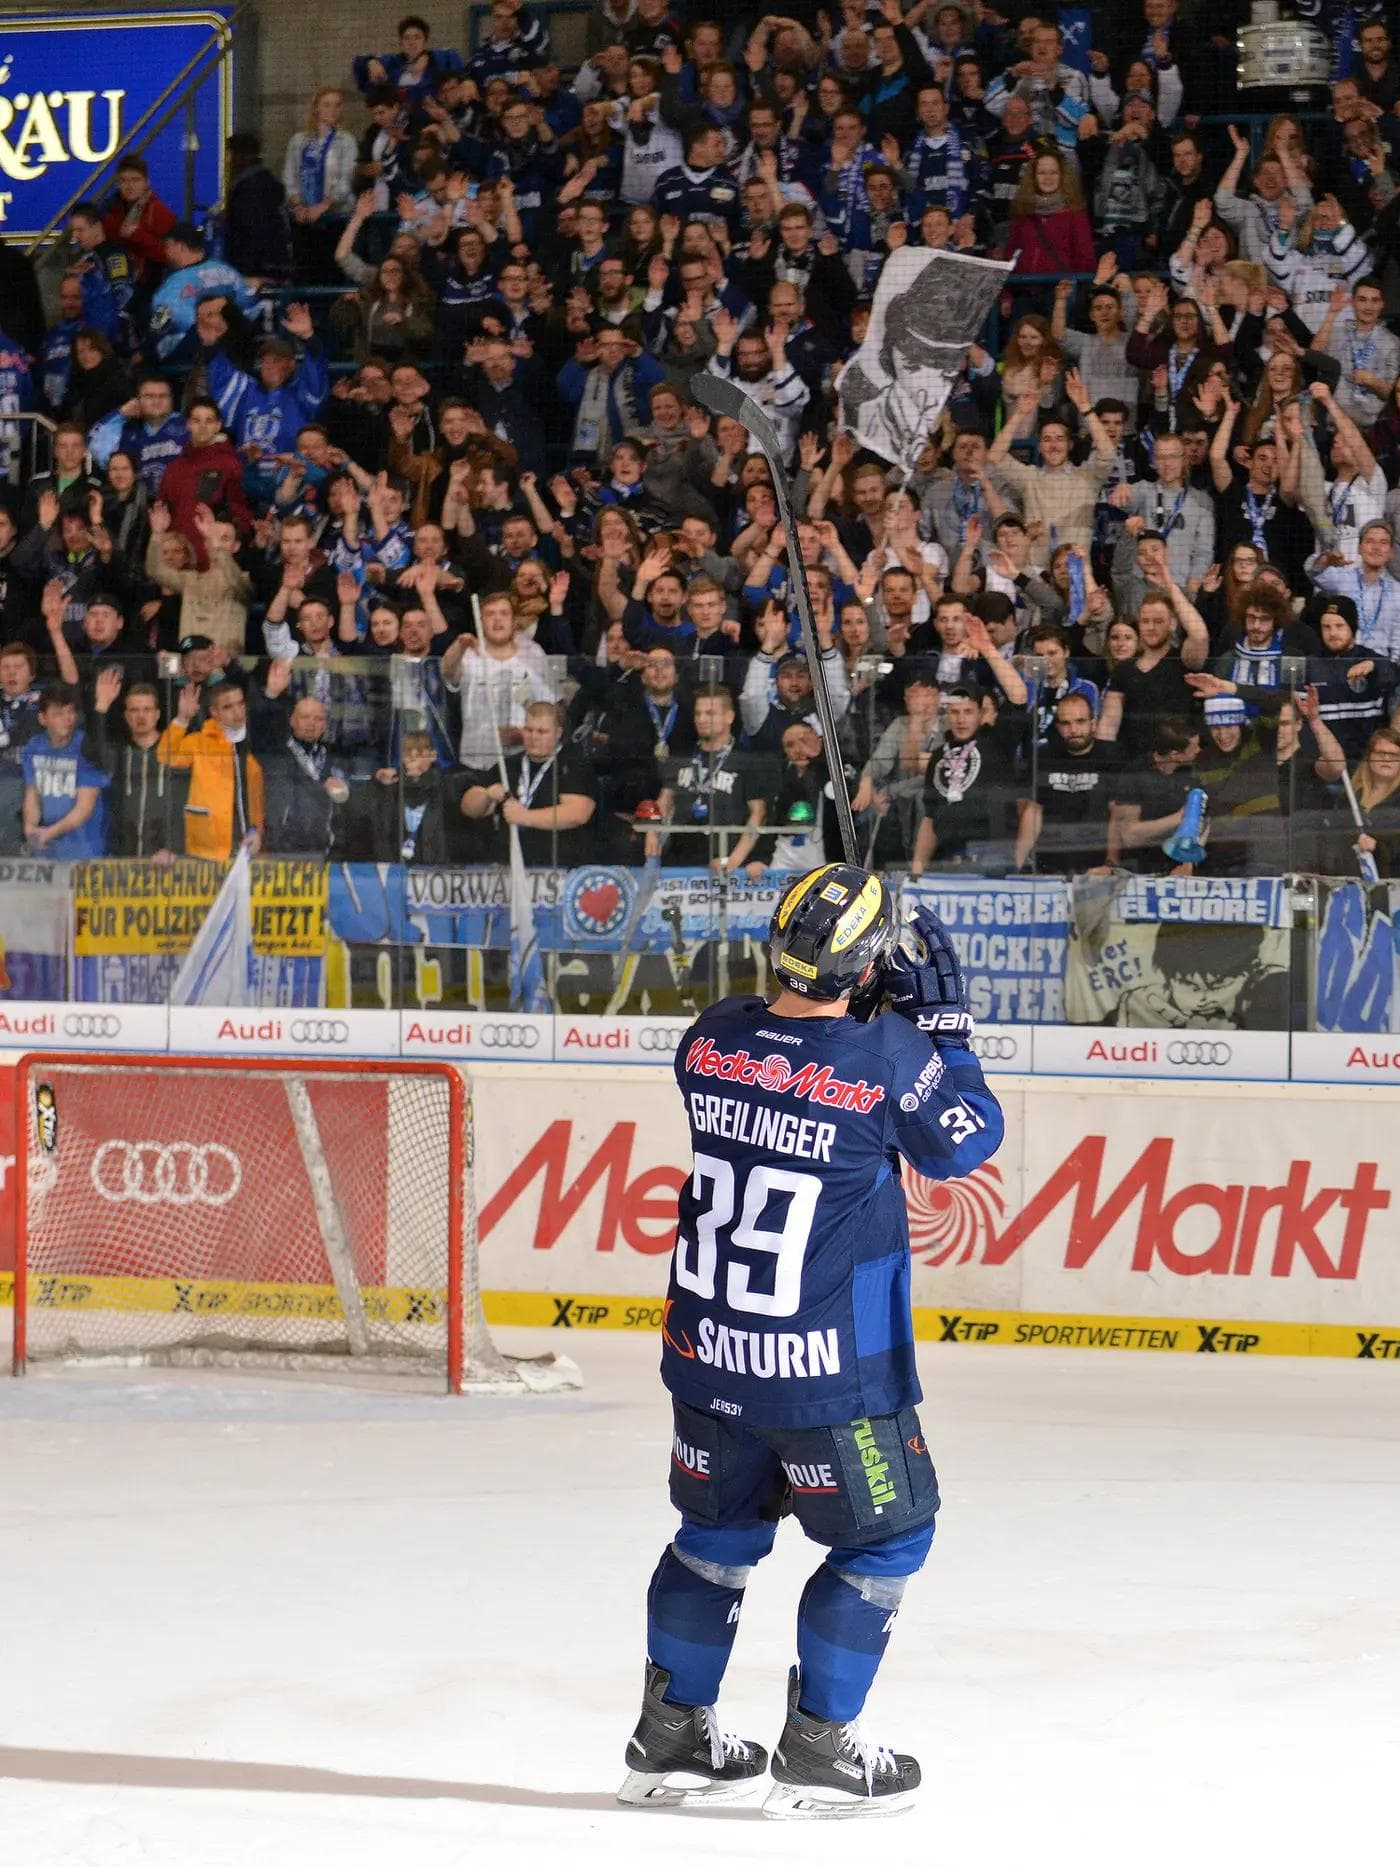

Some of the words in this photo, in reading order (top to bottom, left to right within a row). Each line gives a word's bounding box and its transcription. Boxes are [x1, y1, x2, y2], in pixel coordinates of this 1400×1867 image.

[711, 877, 739, 889] DR
[76, 902, 117, 937] FÜR
[1158, 897, 1268, 923] CUORE
[781, 954, 816, 975] EDEKA
[950, 932, 1066, 974] HOCKEY
[789, 977, 808, 993] 39
[969, 976, 1065, 1021] STER
[219, 1020, 282, 1040] Audi
[406, 1023, 471, 1044] Audi
[564, 1027, 629, 1048] Audi
[755, 1029, 803, 1046] BAUER
[1087, 1039, 1157, 1062] Audi
[778, 1062, 885, 1114] Markt
[690, 1092, 837, 1163] GREILINGER
[981, 1134, 1392, 1281] Markt
[675, 1151, 824, 1318] 39
[696, 1317, 841, 1379] SATURN
[1014, 1323, 1179, 1350] SPORTWETTEN
